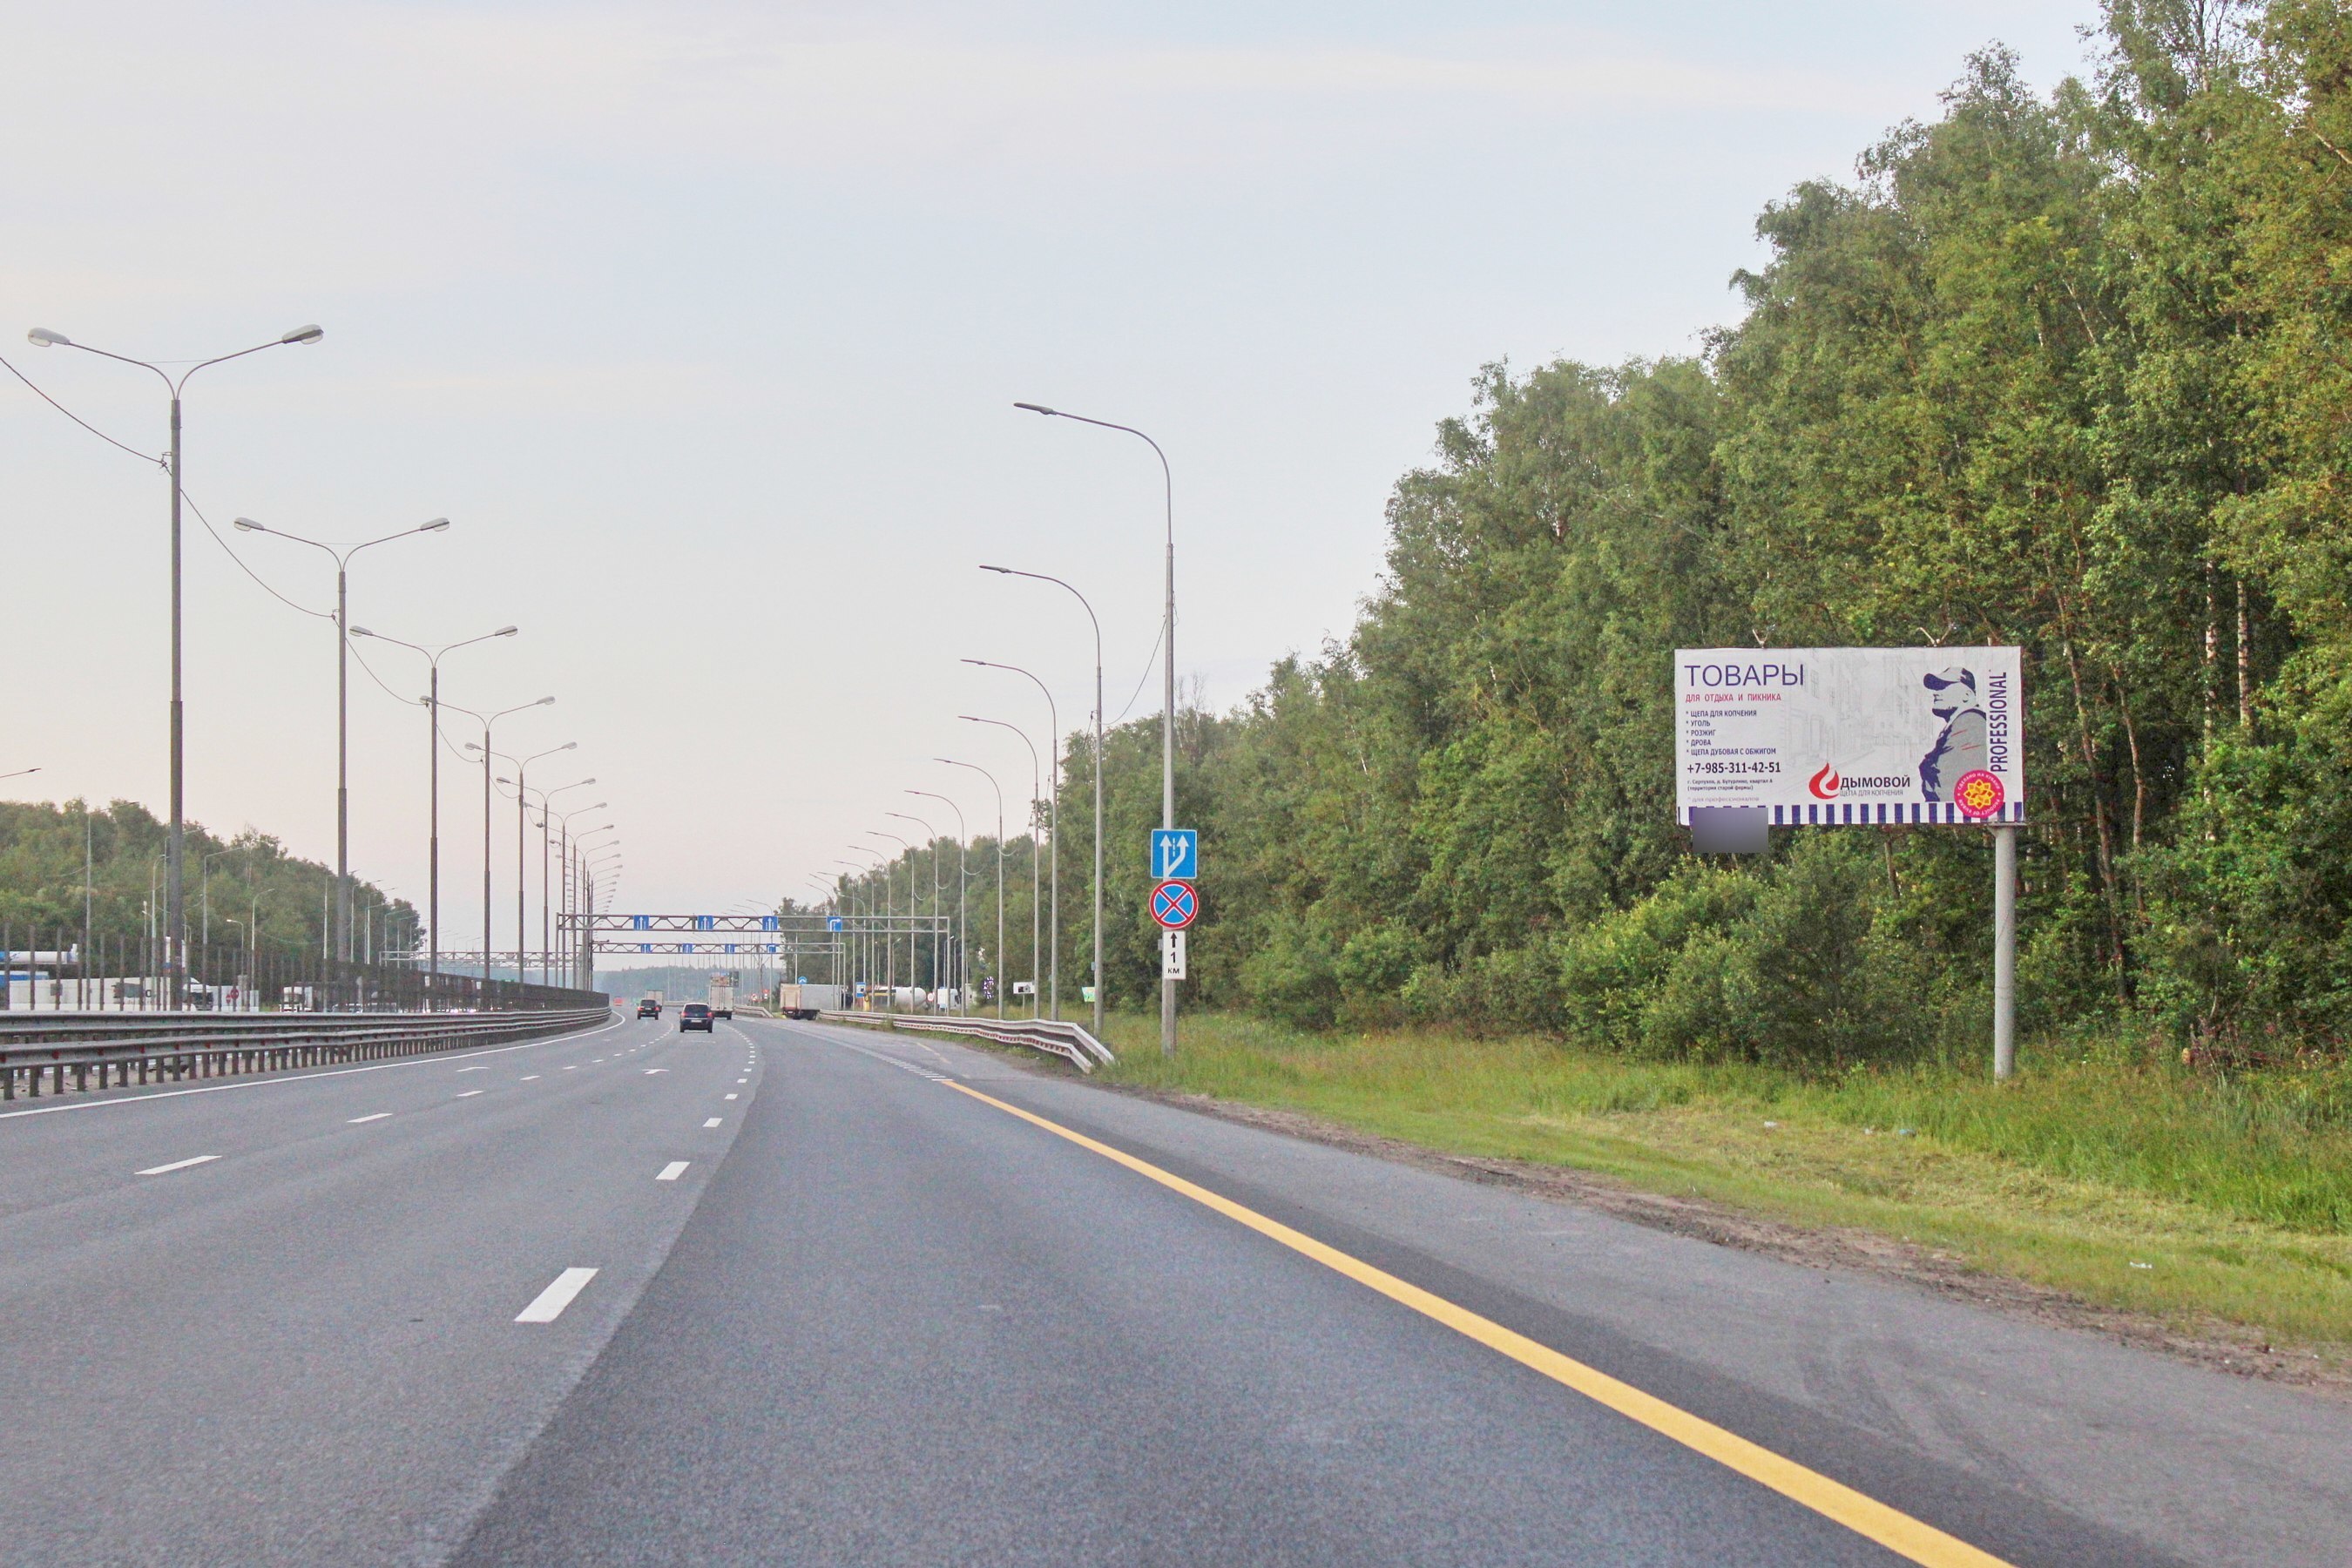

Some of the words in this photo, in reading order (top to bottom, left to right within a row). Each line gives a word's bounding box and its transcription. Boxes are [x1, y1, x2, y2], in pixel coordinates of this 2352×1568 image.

[1684, 664, 1804, 686] ТОВАРЫ
[1686, 694, 1700, 703] ДЛЯ
[1704, 693, 1734, 703] ОТДЫХА
[1989, 672, 2008, 772] PROFESSIONAL
[1687, 762, 1781, 774] +7-985-311-42-51
[1841, 774, 1910, 790] ДЫМОВОЙ
[1170, 951, 1176, 963] 1
